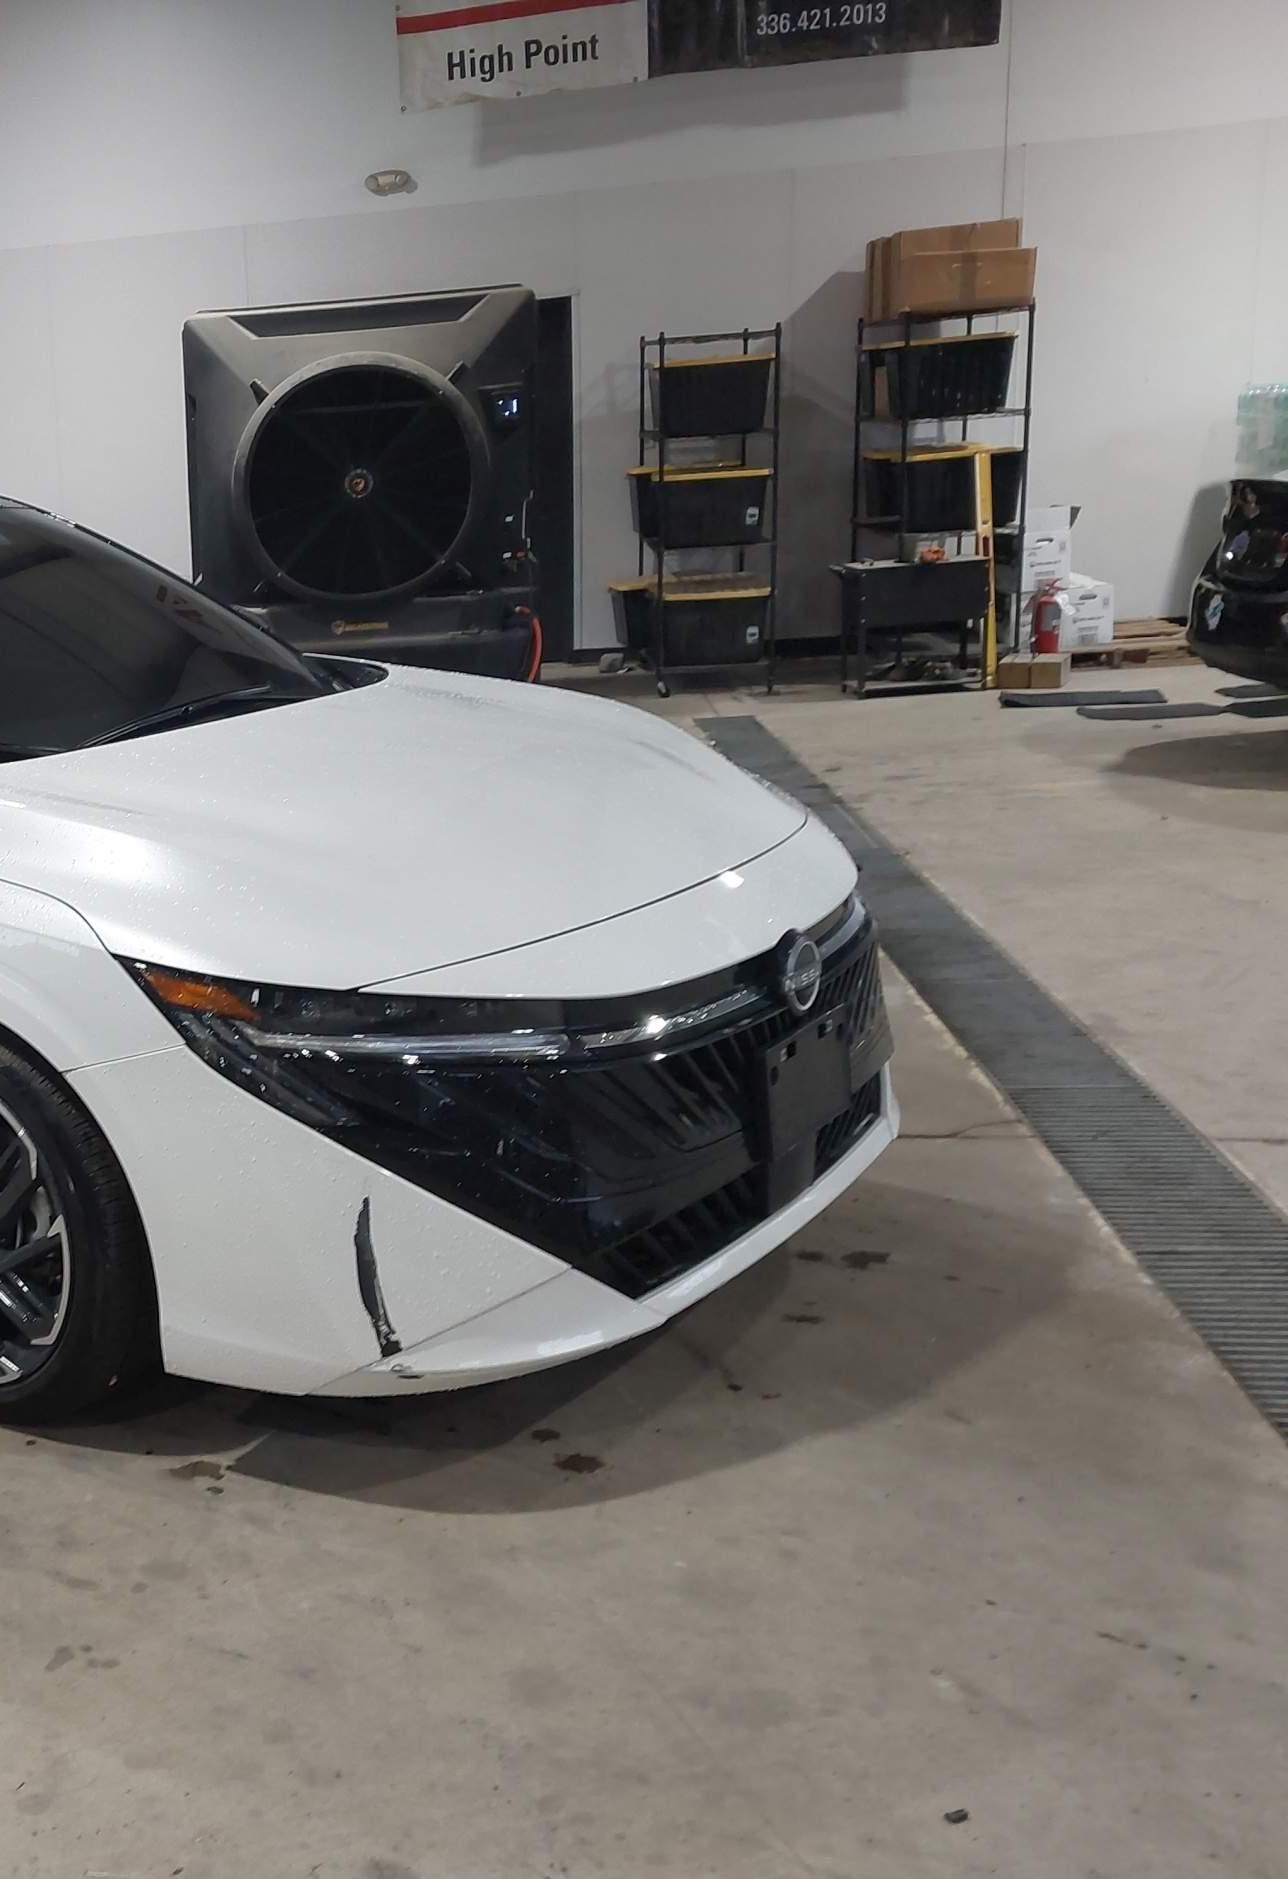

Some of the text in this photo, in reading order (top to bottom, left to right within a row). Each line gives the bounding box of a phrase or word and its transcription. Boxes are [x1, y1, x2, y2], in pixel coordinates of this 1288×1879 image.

[757, 2, 886, 35] 336.421.2013
[447, 34, 599, 82] High Point
